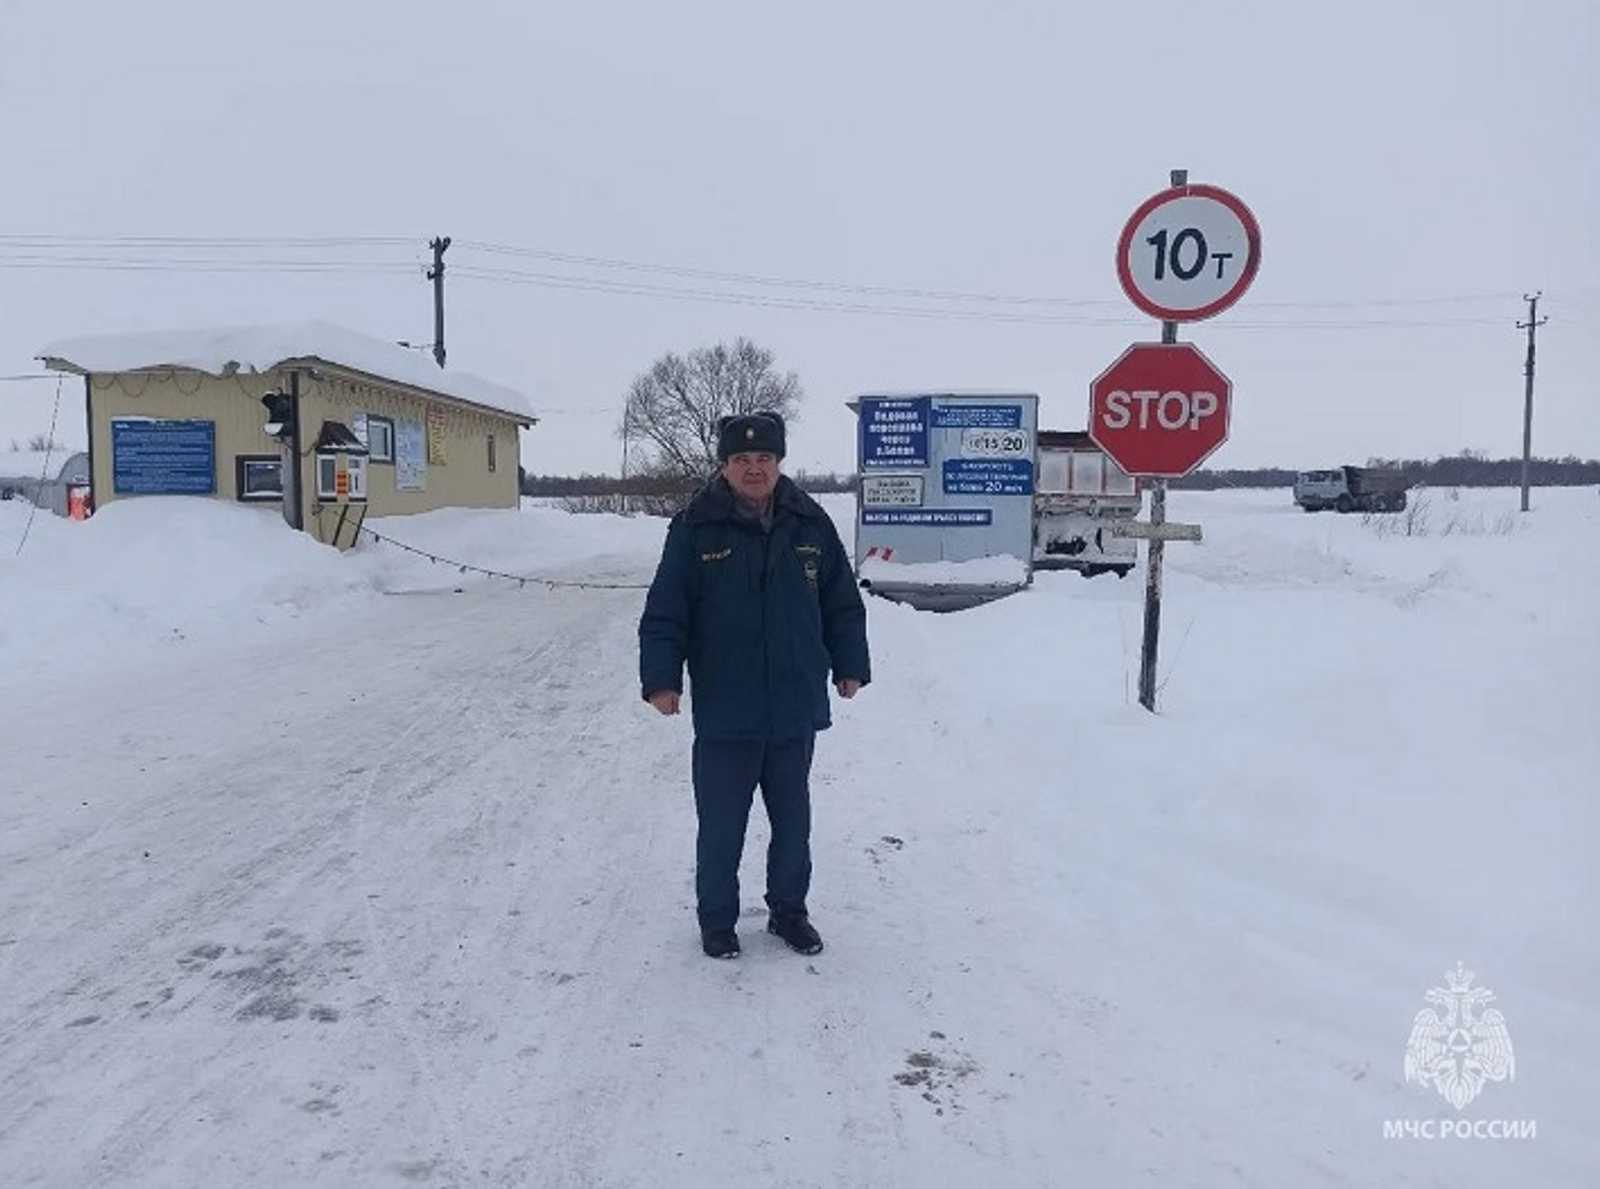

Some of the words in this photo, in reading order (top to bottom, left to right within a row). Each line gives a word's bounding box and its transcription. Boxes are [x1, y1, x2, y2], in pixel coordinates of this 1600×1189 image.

[1146, 227, 1208, 281] 10
[1102, 390, 1218, 431] STOP
[1002, 437, 1023, 451] 20
[985, 481, 1003, 492] 20
